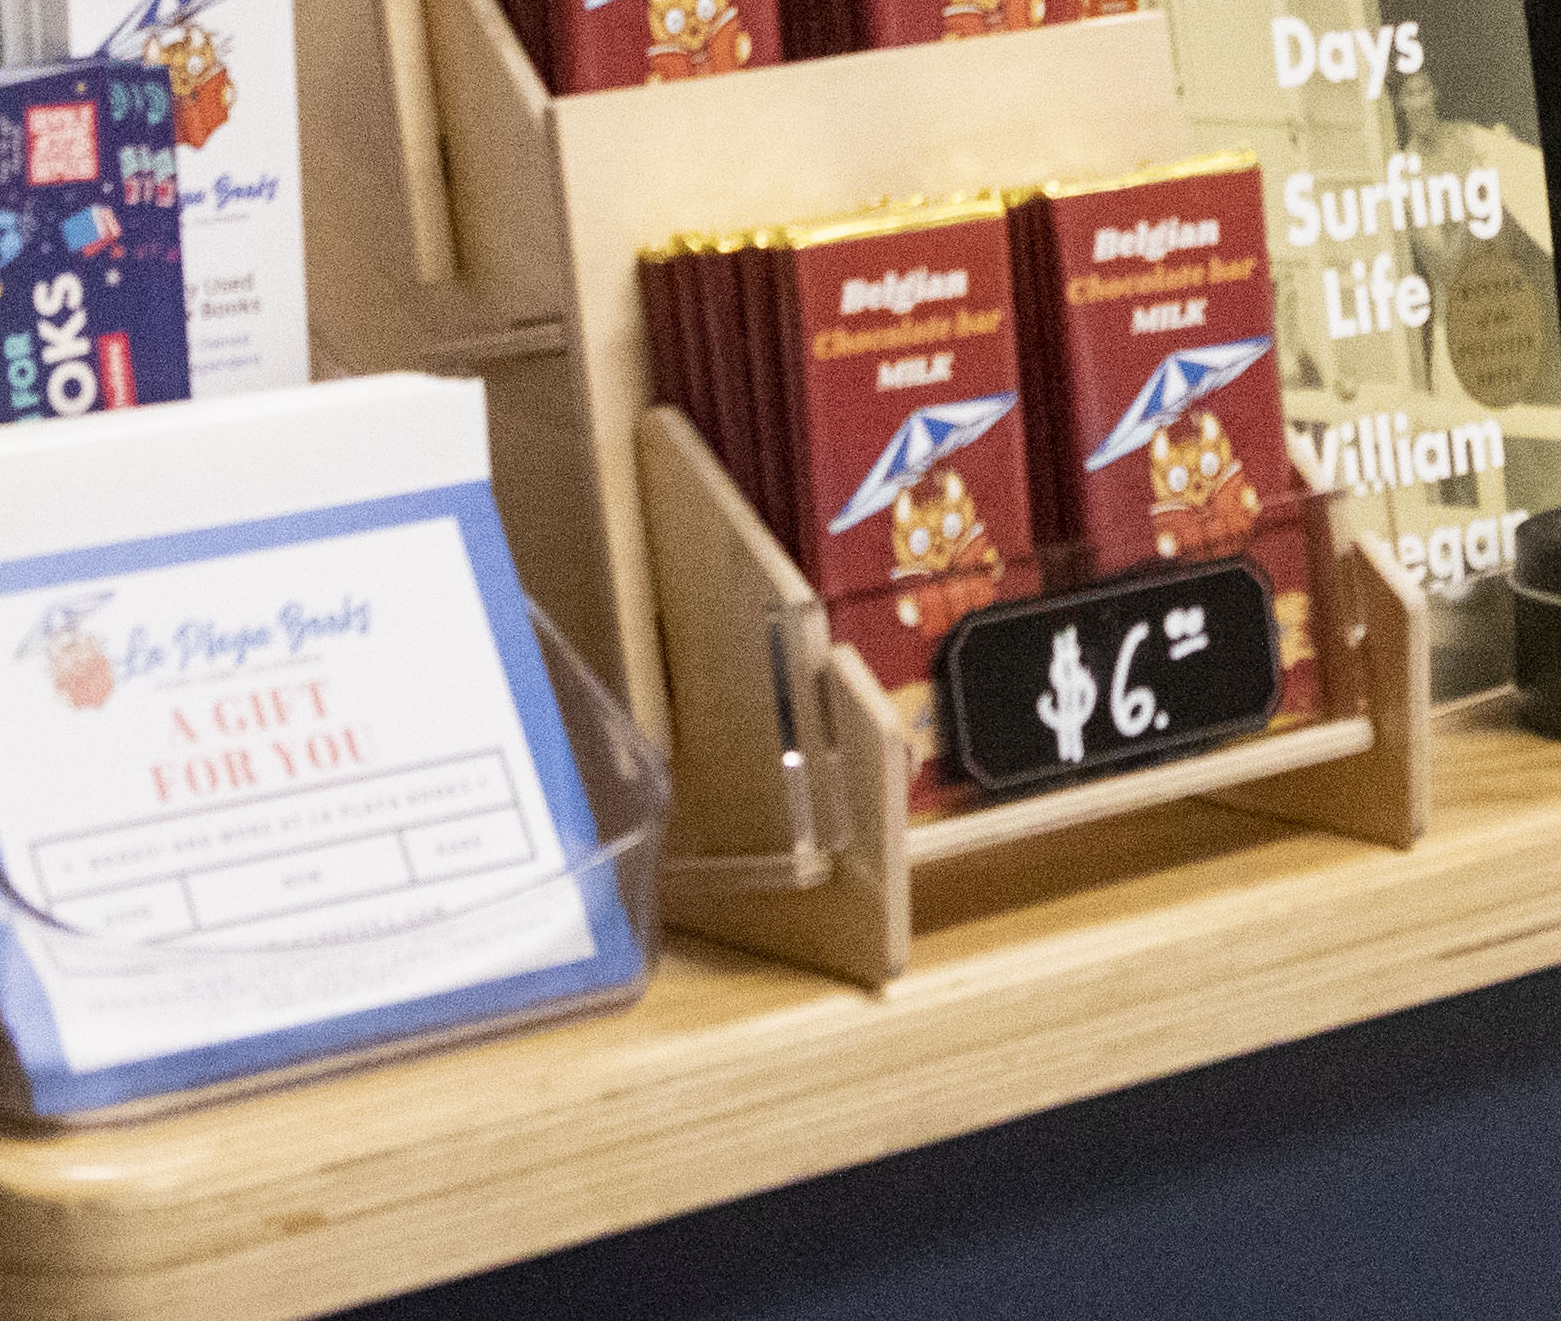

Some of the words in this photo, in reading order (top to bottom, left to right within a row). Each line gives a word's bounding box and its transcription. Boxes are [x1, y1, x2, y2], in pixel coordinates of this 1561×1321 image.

[1272, 17, 1426, 100] Days
[1284, 150, 1502, 247] Surfing
[1093, 216, 1221, 264] Belgian
[840, 266, 968, 315] Belgian
[1066, 263, 1200, 306] Chocolate
[1207, 252, 1257, 283] bar
[1323, 258, 1433, 341] Life
[33, 272, 98, 417] OKS
[812, 318, 952, 360] Chocolate
[955, 308, 1003, 338] bar
[1131, 298, 1207, 337] MILK
[876, 351, 954, 393] MILK
[120, 626, 165, 681] La
[174, 610, 270, 673] Playa
[281, 595, 373, 653] Books
[168, 708, 198, 745] A
[212, 677, 330, 734] GIFT
[149, 748, 258, 806] FOR
[276, 723, 373, 783] YOU
